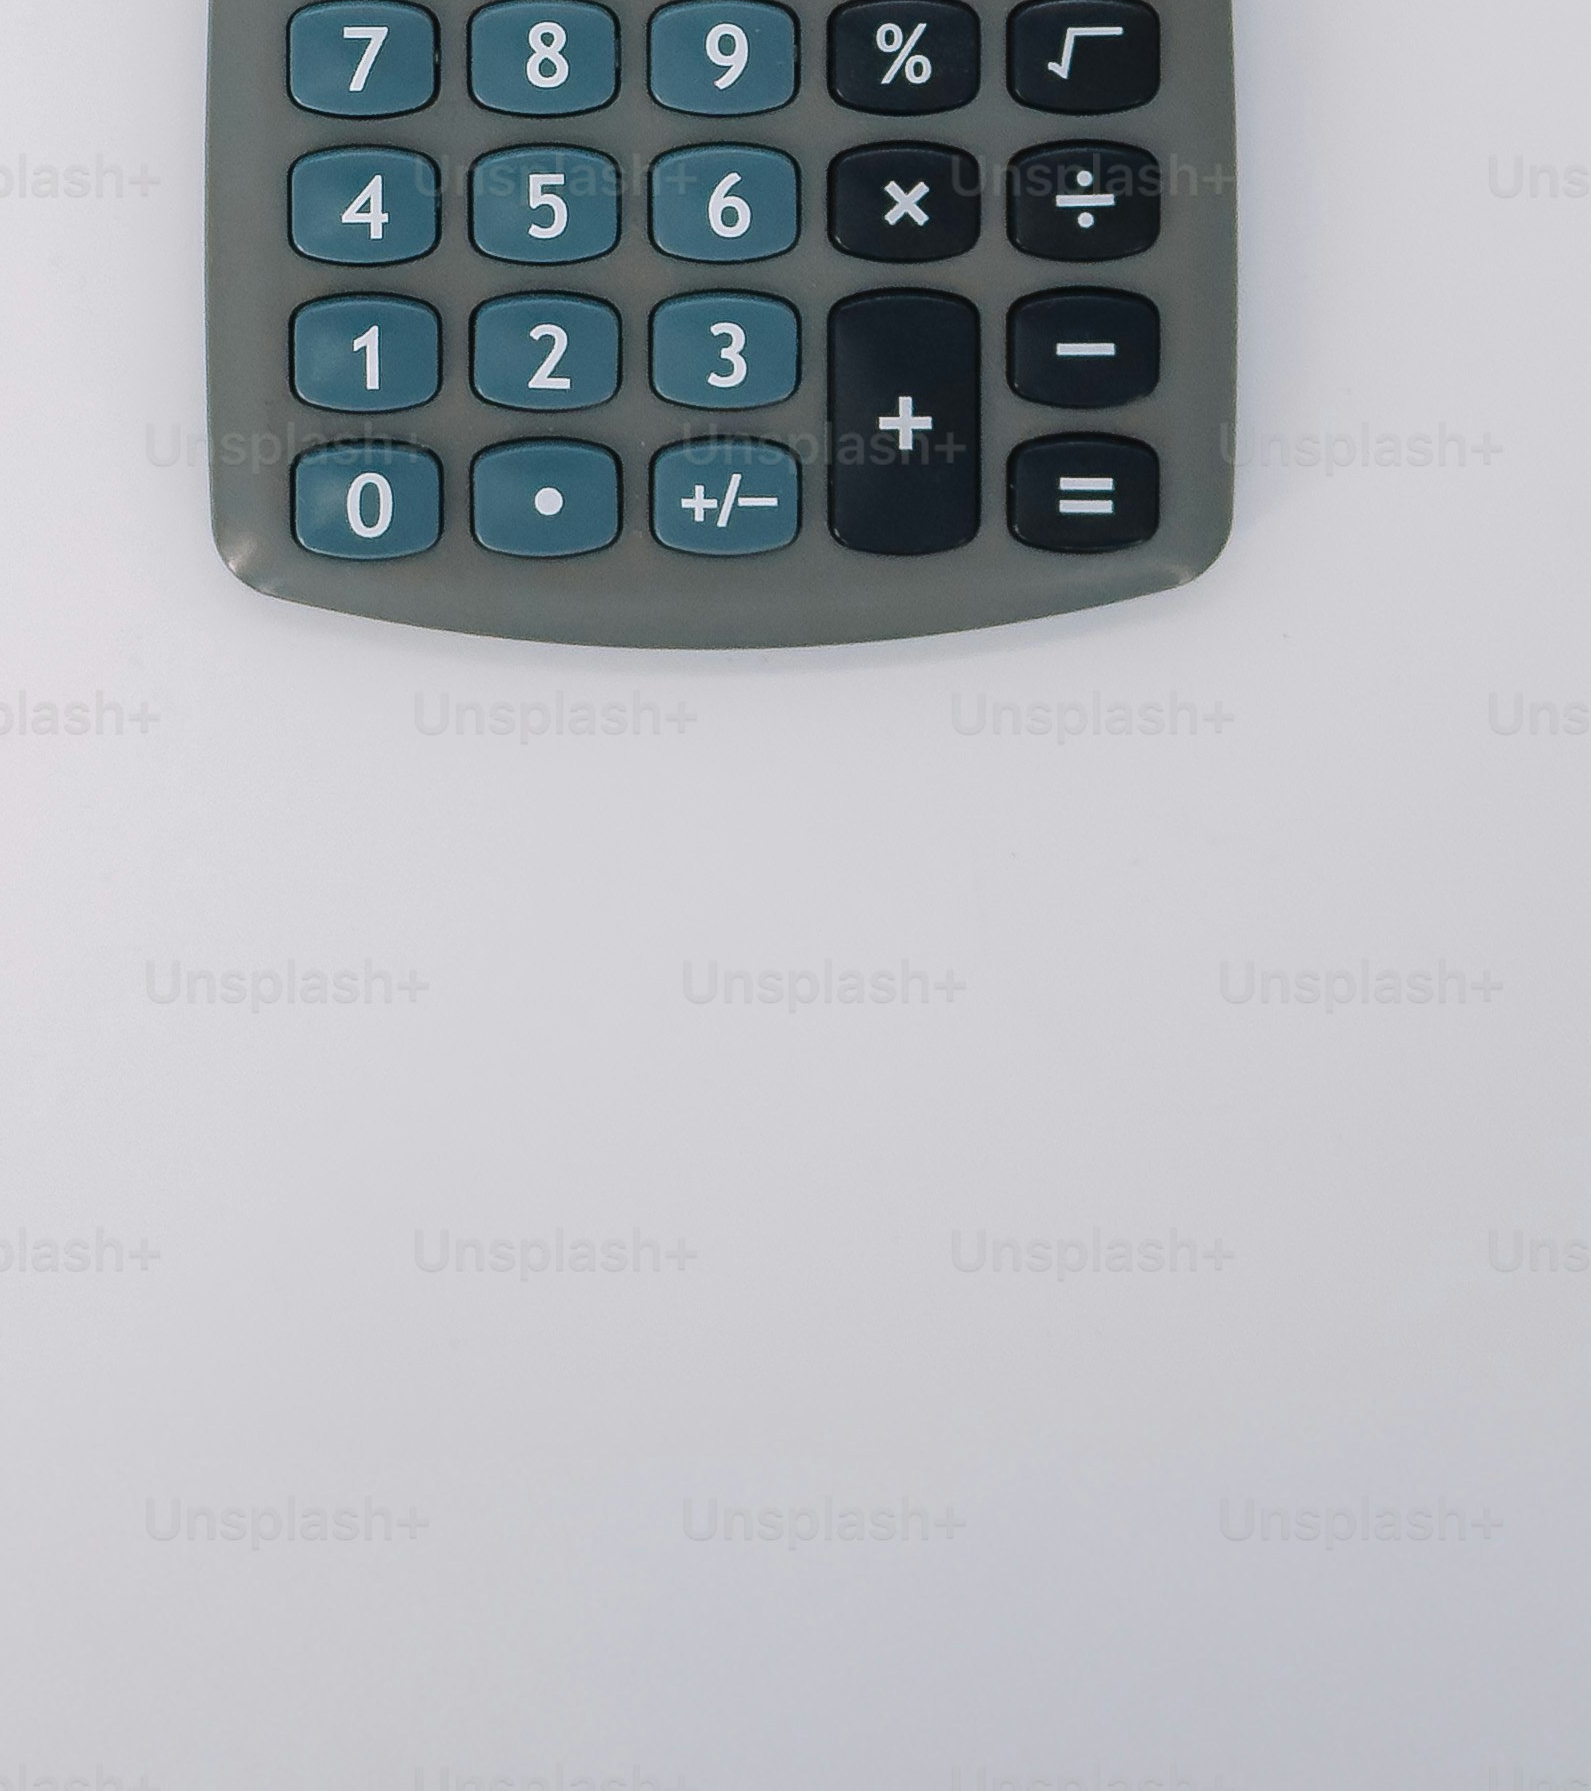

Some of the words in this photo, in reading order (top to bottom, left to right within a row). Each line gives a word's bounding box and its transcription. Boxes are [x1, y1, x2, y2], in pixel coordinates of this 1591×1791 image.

[342, 25, 390, 93] 7
[525, 20, 570, 89] 8
[704, 22, 750, 91] 9
[875, 22, 933, 85] %
[340, 173, 390, 240] 4
[527, 172, 569, 240] 5
[707, 171, 752, 239] 6
[352, 324, 381, 391] 1
[527, 323, 572, 391] 2
[706, 321, 748, 389] 3
[345, 471, 394, 539] 0
